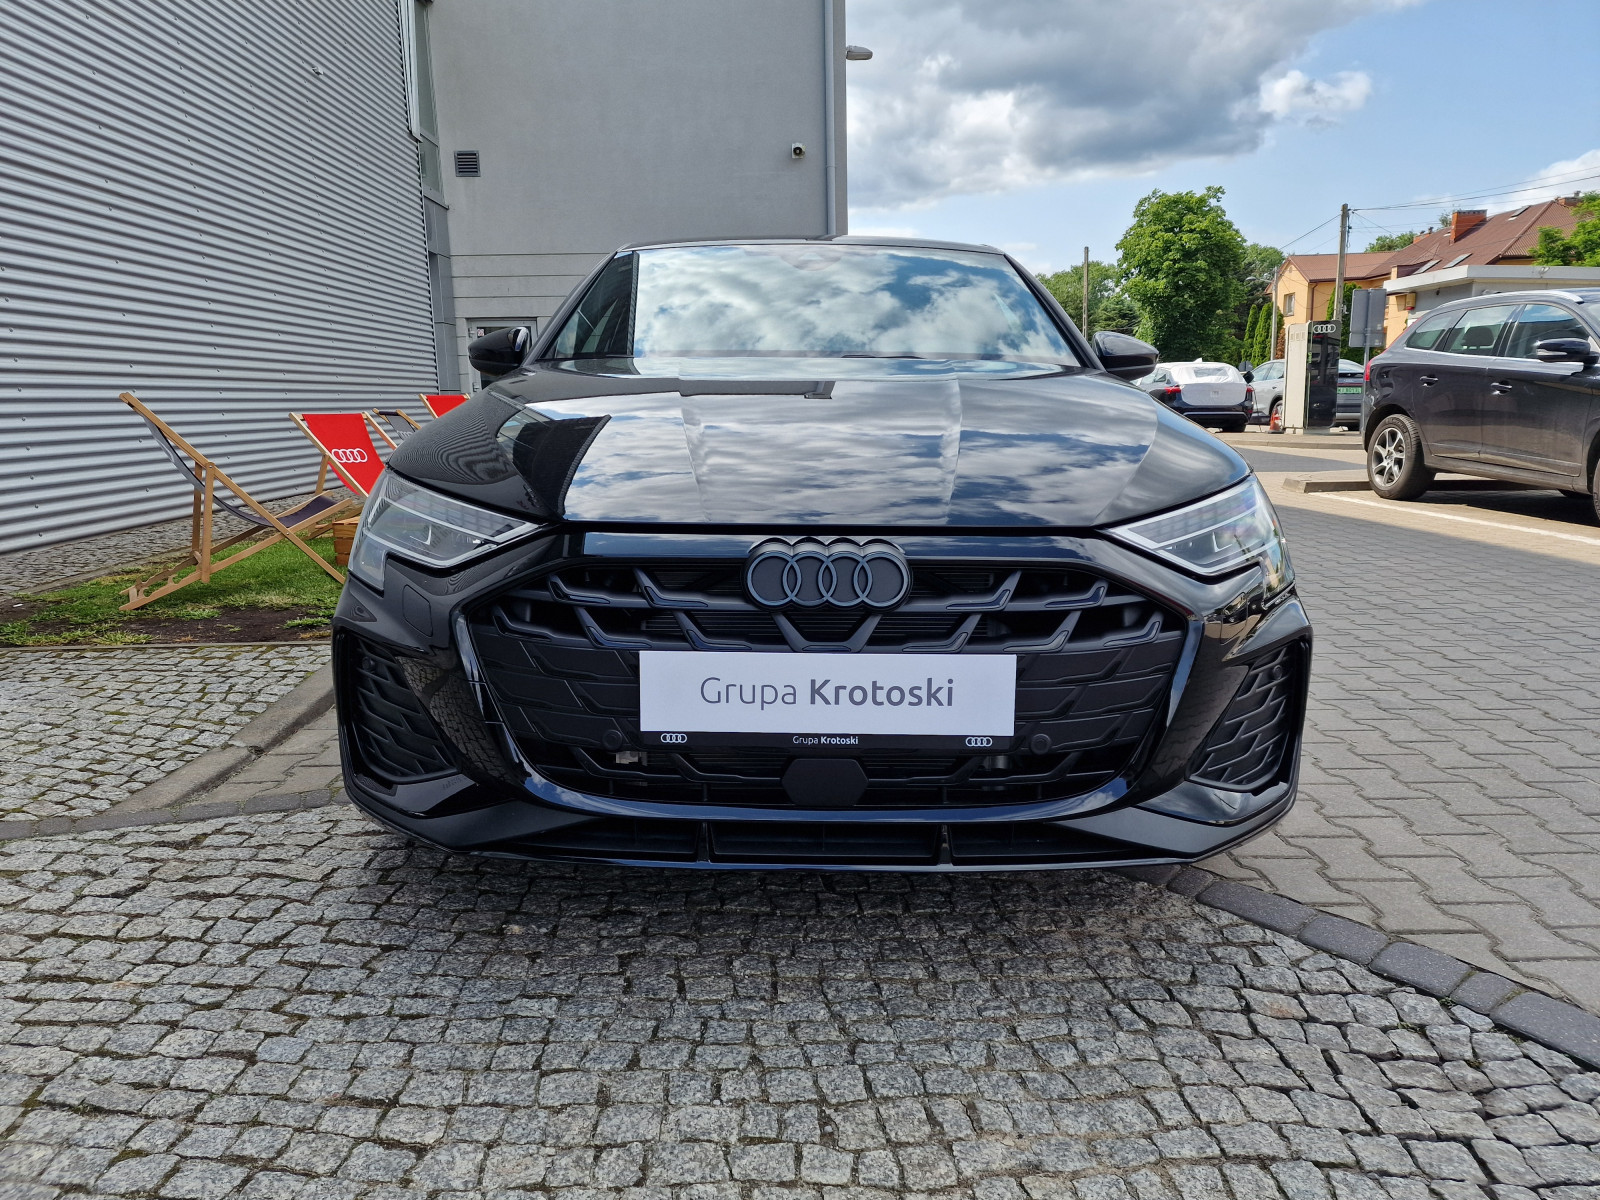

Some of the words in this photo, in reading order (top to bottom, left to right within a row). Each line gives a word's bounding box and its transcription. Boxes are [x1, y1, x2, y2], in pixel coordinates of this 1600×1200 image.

[700, 676, 798, 711] Grupa
[809, 677, 955, 707] Krotoski
[792, 735, 819, 746] Grupa
[820, 735, 859, 745] Krotoski
